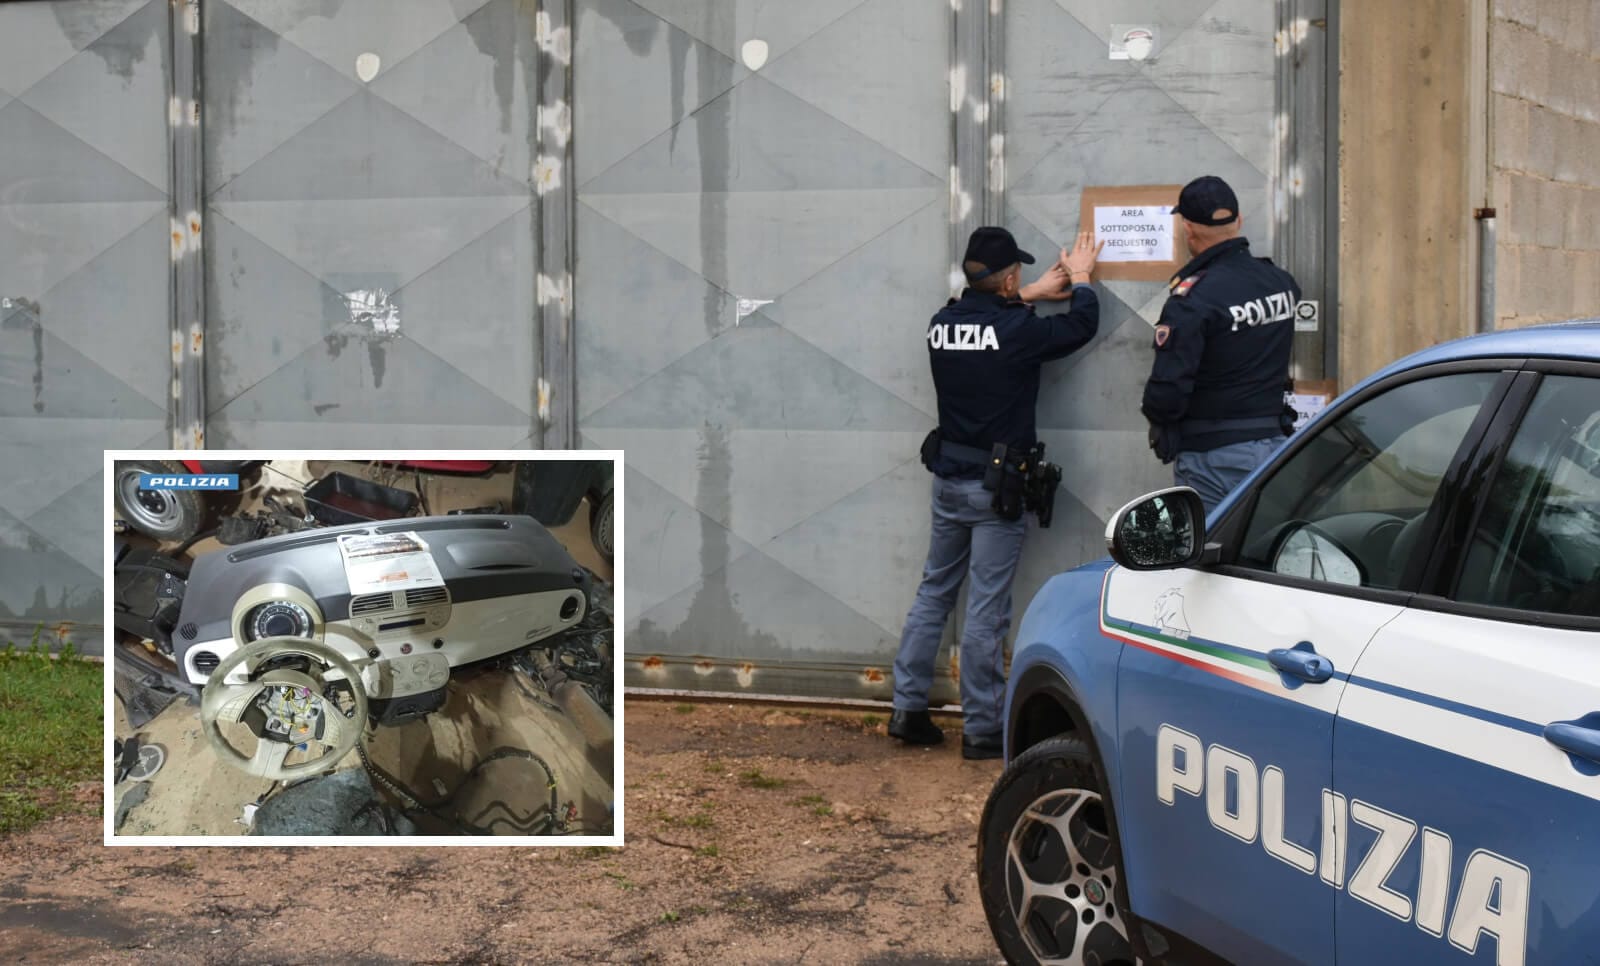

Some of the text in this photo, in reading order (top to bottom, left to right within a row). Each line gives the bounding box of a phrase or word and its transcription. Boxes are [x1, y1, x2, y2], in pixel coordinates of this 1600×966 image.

[1121, 208, 1144, 217] AREA
[1100, 224, 1165, 233] SOTTOPOSTA A
[1107, 238, 1158, 248] SEQUESTRO
[928, 324, 999, 350] OLIZIA
[1155, 721, 1531, 966] POLIZIA
